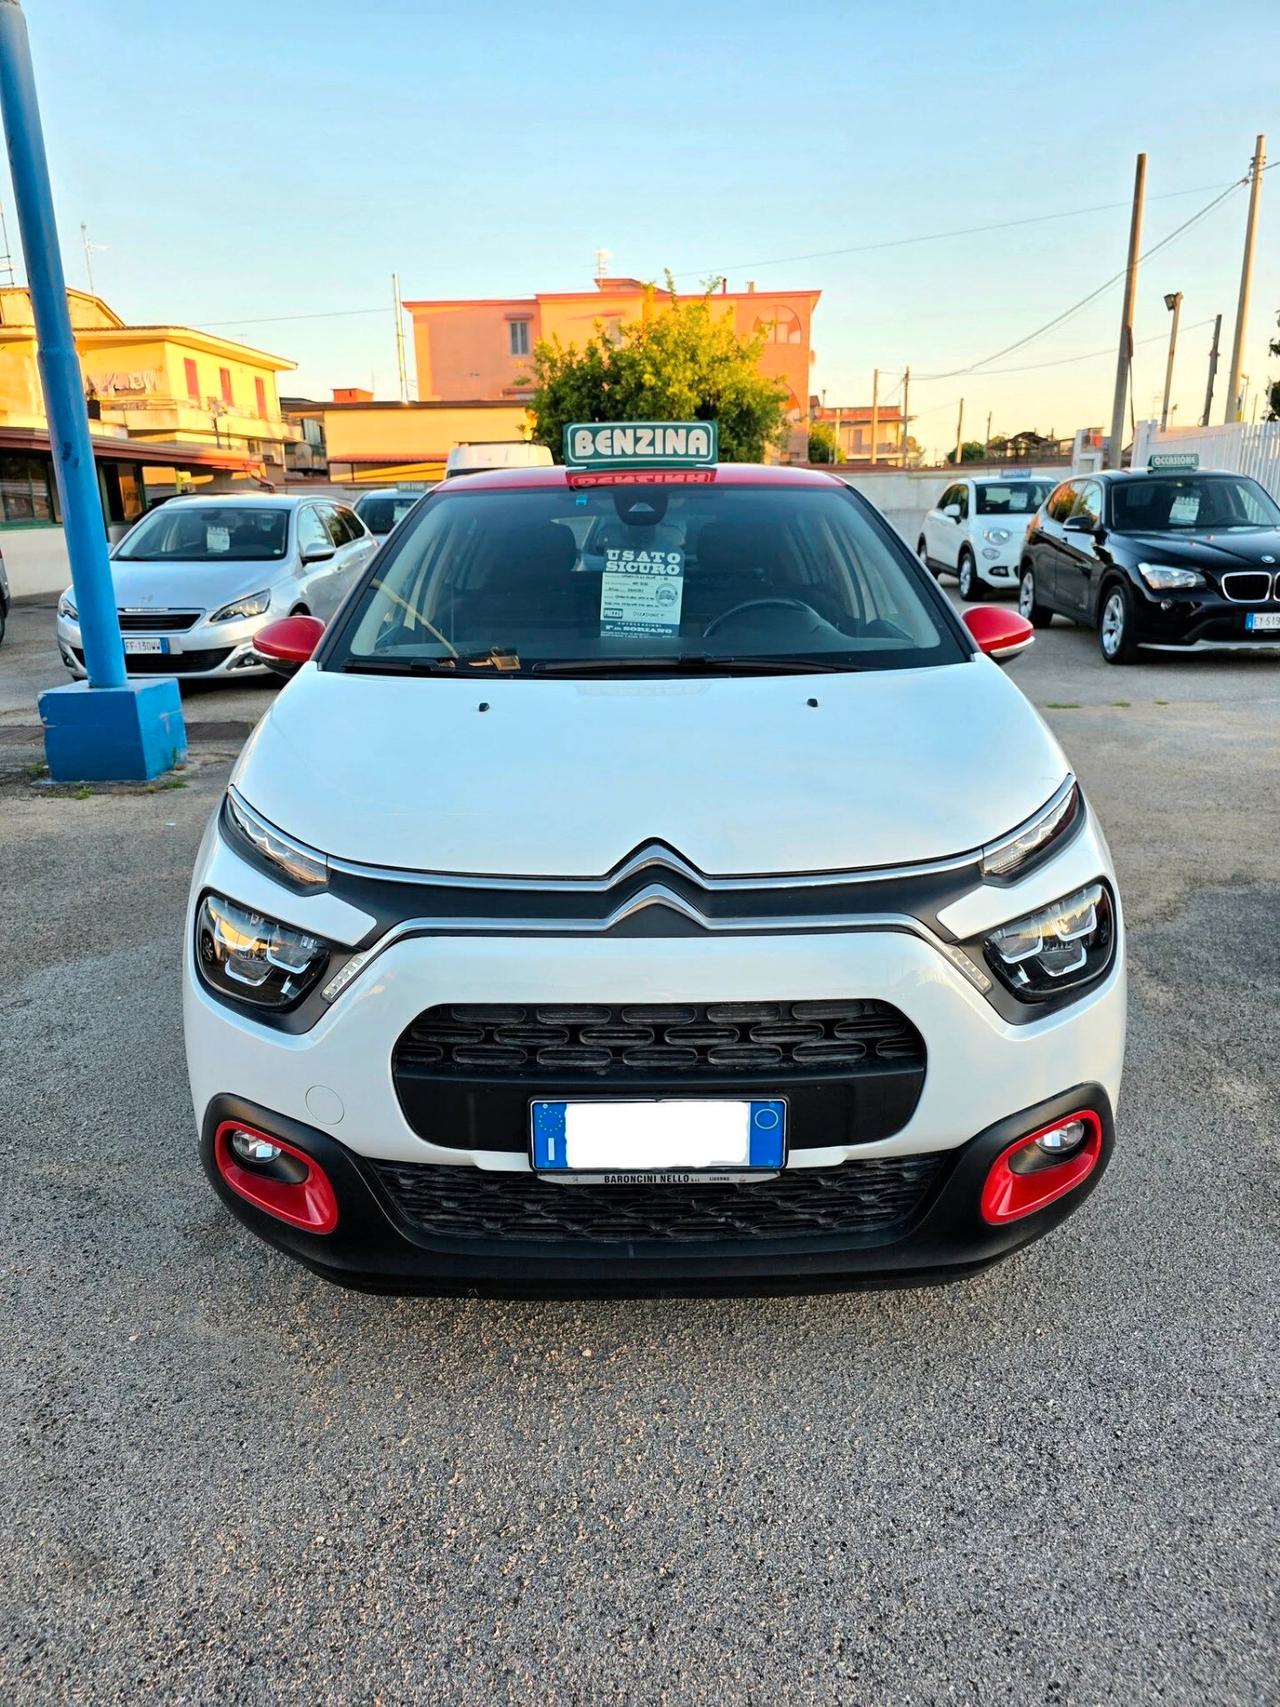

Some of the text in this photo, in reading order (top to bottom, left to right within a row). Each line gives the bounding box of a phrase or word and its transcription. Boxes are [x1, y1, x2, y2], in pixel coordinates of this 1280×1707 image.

[574, 428, 708, 457] BENZINA
[606, 549, 681, 564] USATO
[605, 560, 680, 575] SICURO
[604, 1175, 657, 1184] BARONCINI
[660, 1174, 690, 1183] NELLO
